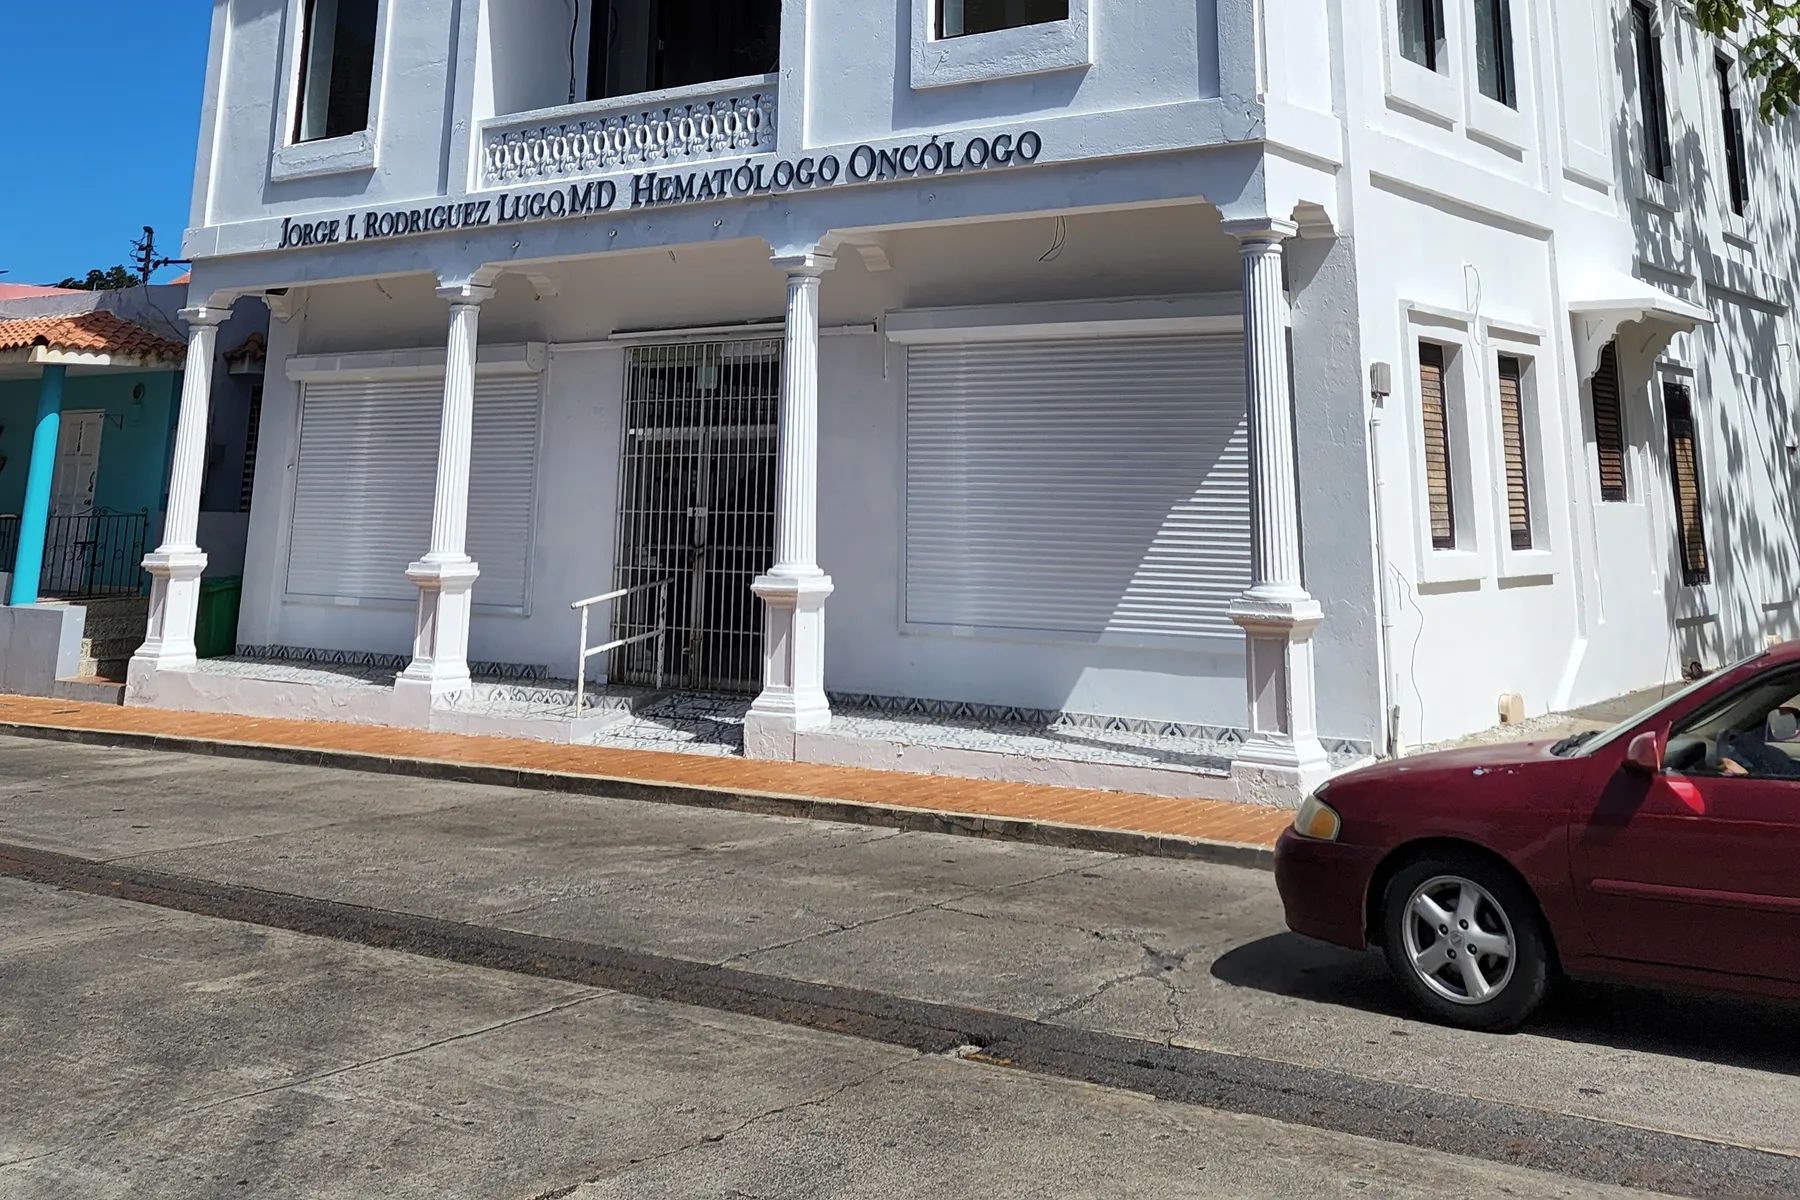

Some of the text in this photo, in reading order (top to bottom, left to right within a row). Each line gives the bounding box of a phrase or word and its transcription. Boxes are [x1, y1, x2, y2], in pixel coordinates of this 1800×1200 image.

[278, 217, 340, 249] JORGE
[364, 200, 491, 239] RODRIGUEZ
[632, 154, 840, 206] HEMATÓLOGO
[848, 131, 1042, 179] ONCÓLOGO
